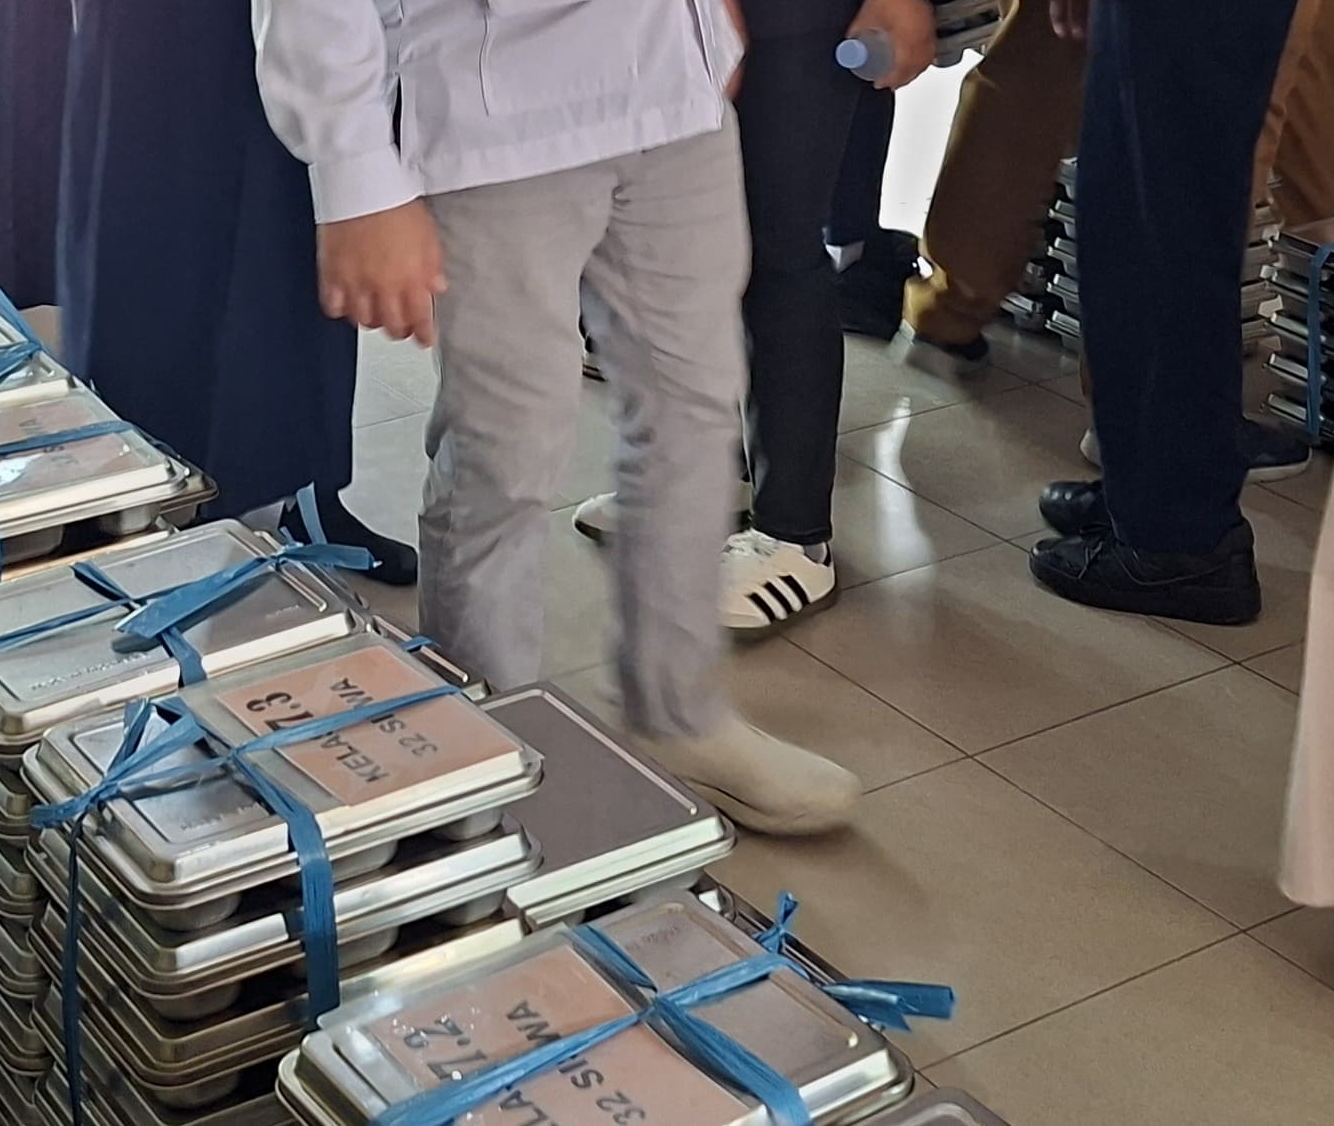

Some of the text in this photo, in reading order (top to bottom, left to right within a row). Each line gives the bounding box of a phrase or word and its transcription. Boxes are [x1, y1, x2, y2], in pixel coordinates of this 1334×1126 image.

[246, 691, 315, 731] 7.3
[330, 677, 438, 759] 32 SIWA
[310, 730, 391, 783] KELA
[403, 1014, 488, 1080] 7.2
[505, 999, 604, 1090] SIWA
[596, 1090, 646, 1126] 32
